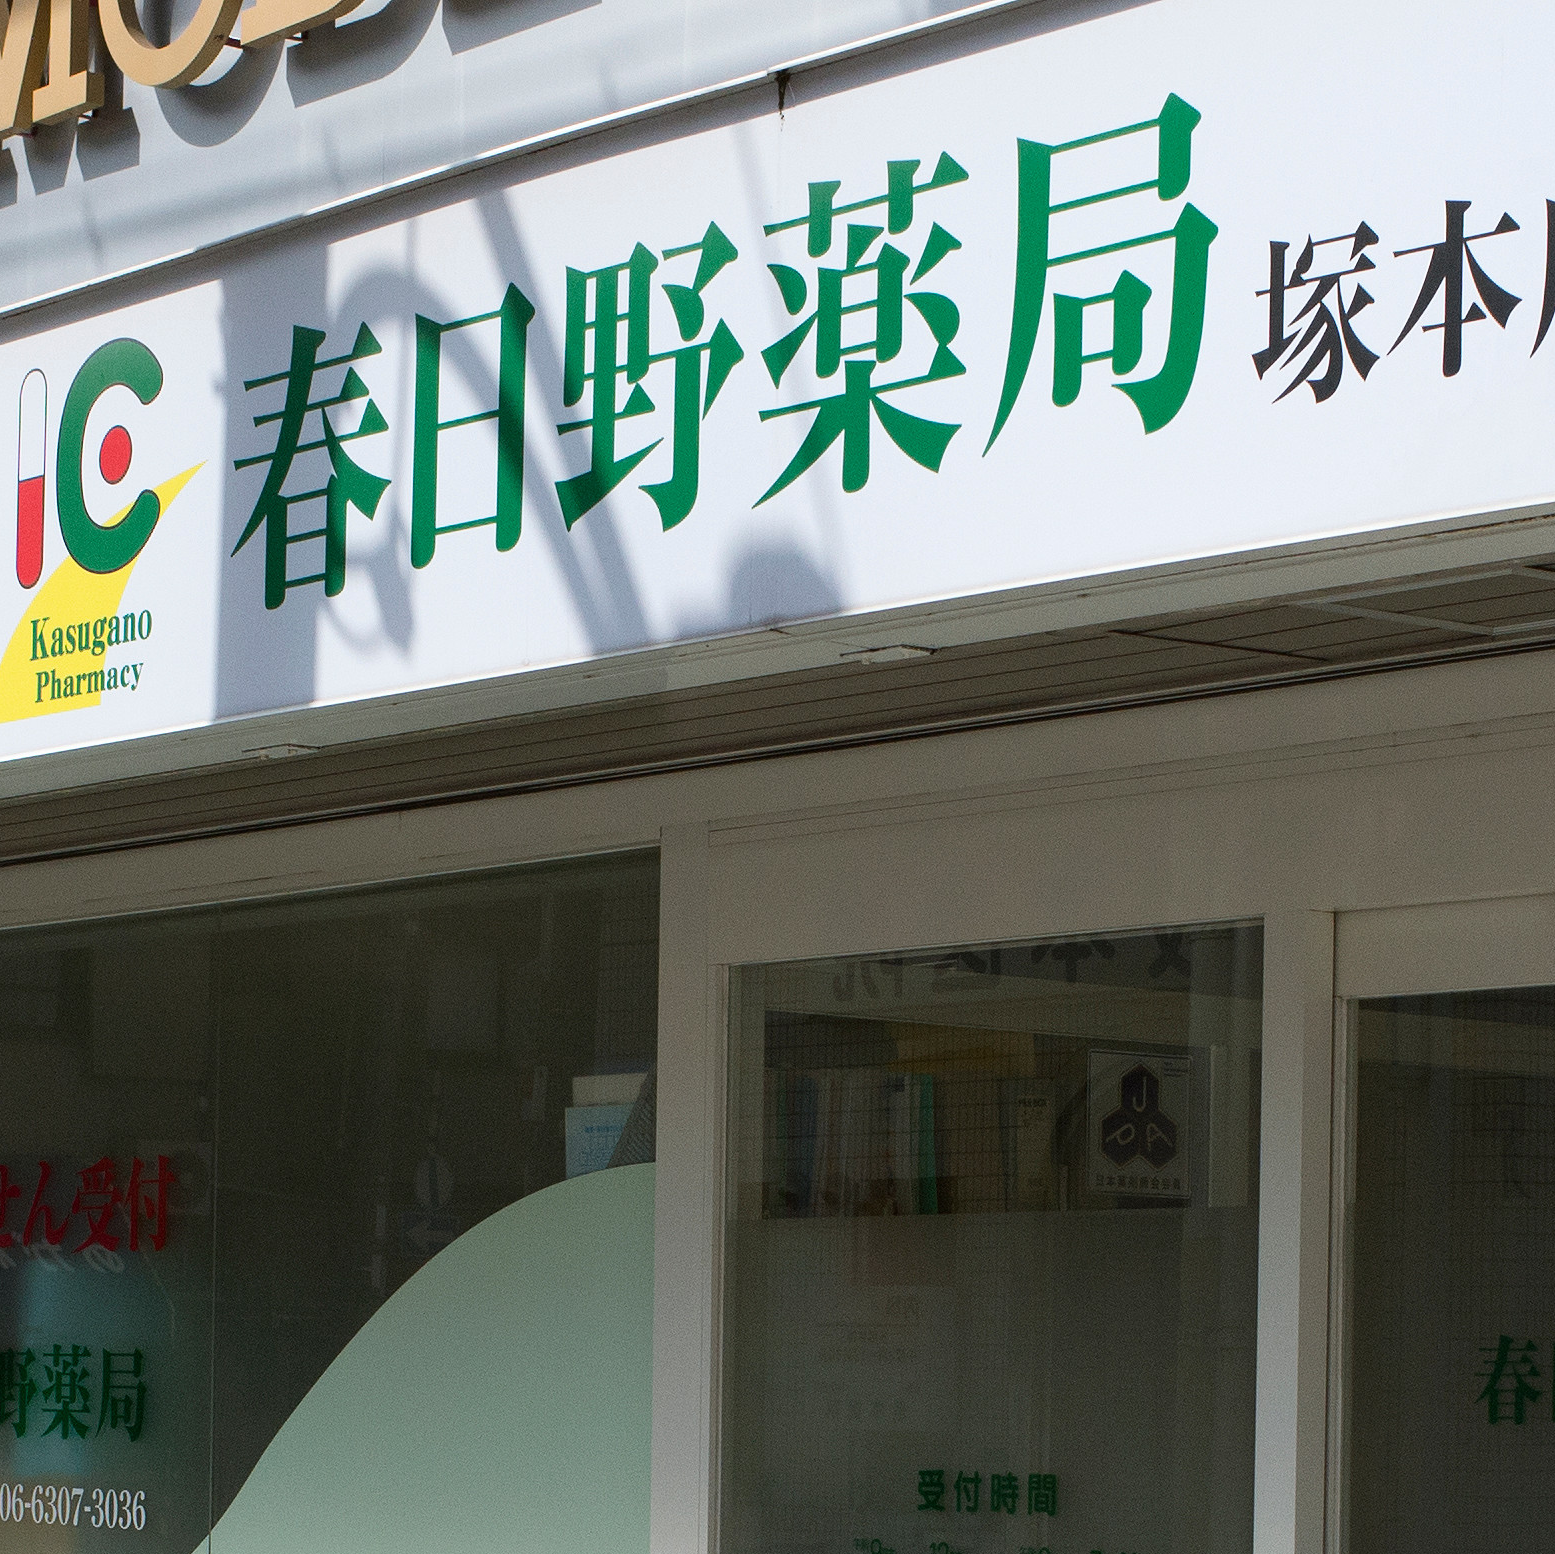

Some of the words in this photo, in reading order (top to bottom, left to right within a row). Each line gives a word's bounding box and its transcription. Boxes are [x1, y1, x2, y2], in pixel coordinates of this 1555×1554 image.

[231, 94, 1220, 611] 春日野薬局
[28, 604, 153, 664] Kasugano
[33, 658, 144, 704] Pharmacy
[916, 1469, 1058, 1516] 受付時間
